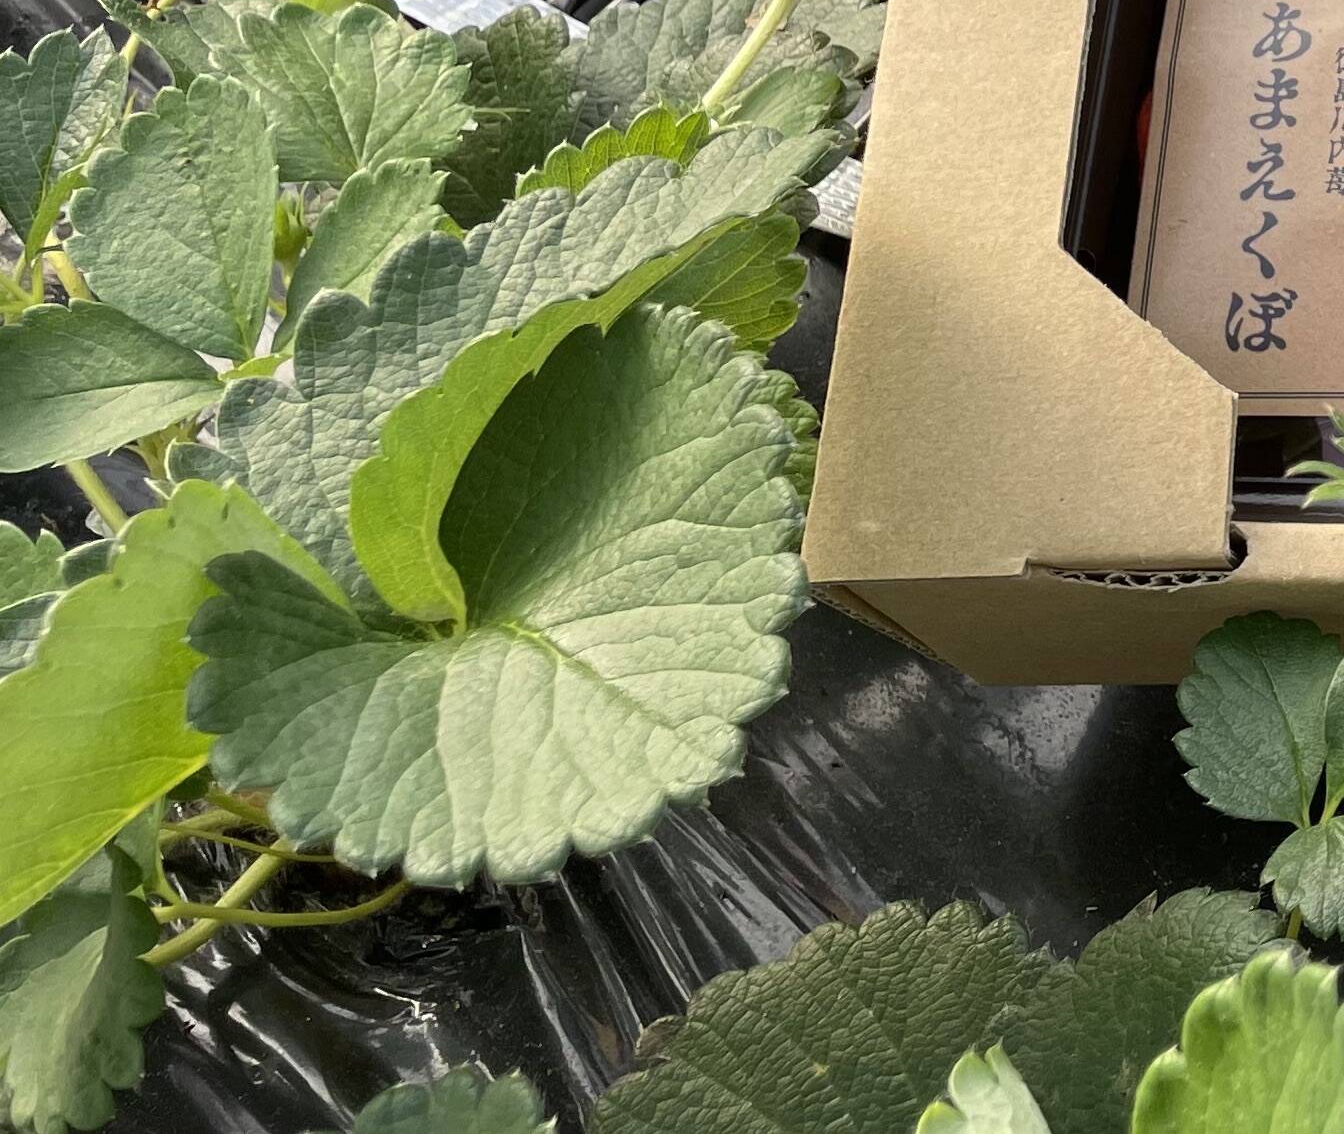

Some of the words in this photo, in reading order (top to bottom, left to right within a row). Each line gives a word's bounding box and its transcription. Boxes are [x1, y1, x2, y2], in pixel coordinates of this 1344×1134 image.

[1224, 2, 1312, 352] あまえくぼ
